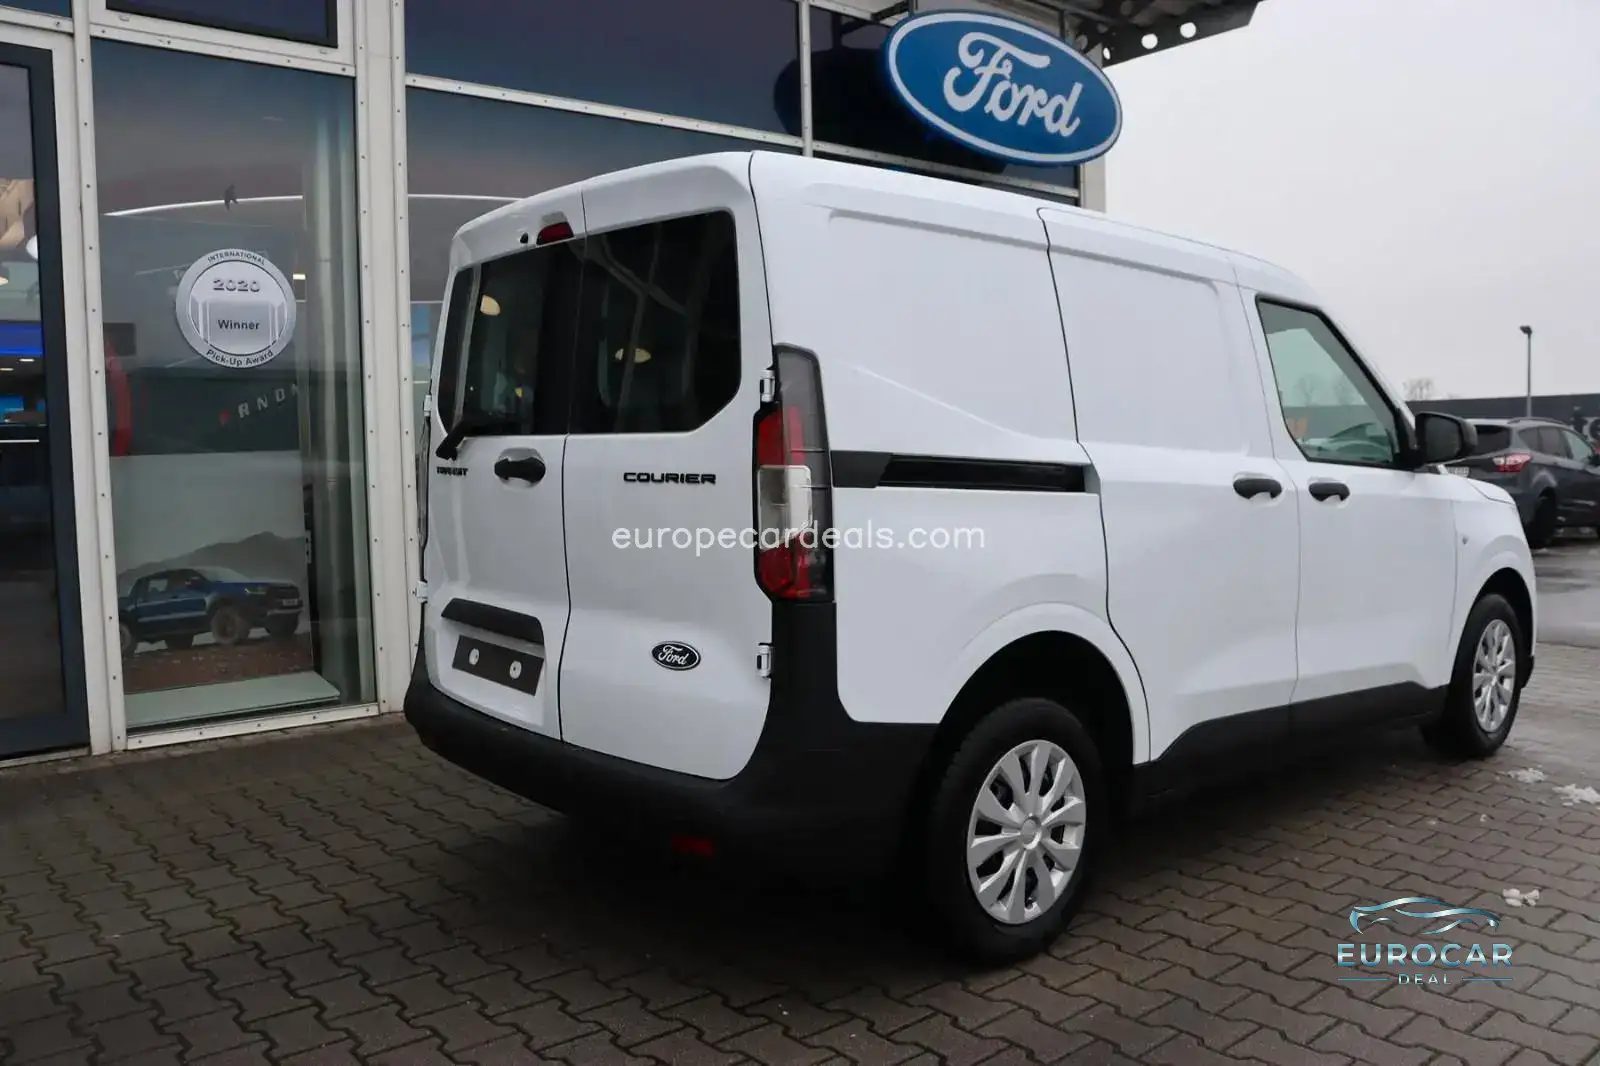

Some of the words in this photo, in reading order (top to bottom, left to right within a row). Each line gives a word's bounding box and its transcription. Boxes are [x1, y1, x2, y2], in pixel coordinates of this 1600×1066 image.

[943, 32, 1083, 137] Ford
[207, 250, 265, 266] INTERNATIONAL
[213, 278, 261, 293] 2020
[217, 319, 260, 330] Winner
[206, 349, 243, 367] Pick-Up
[245, 350, 274, 365] Award
[623, 472, 717, 485] COURIER
[658, 644, 690, 665] Ford
